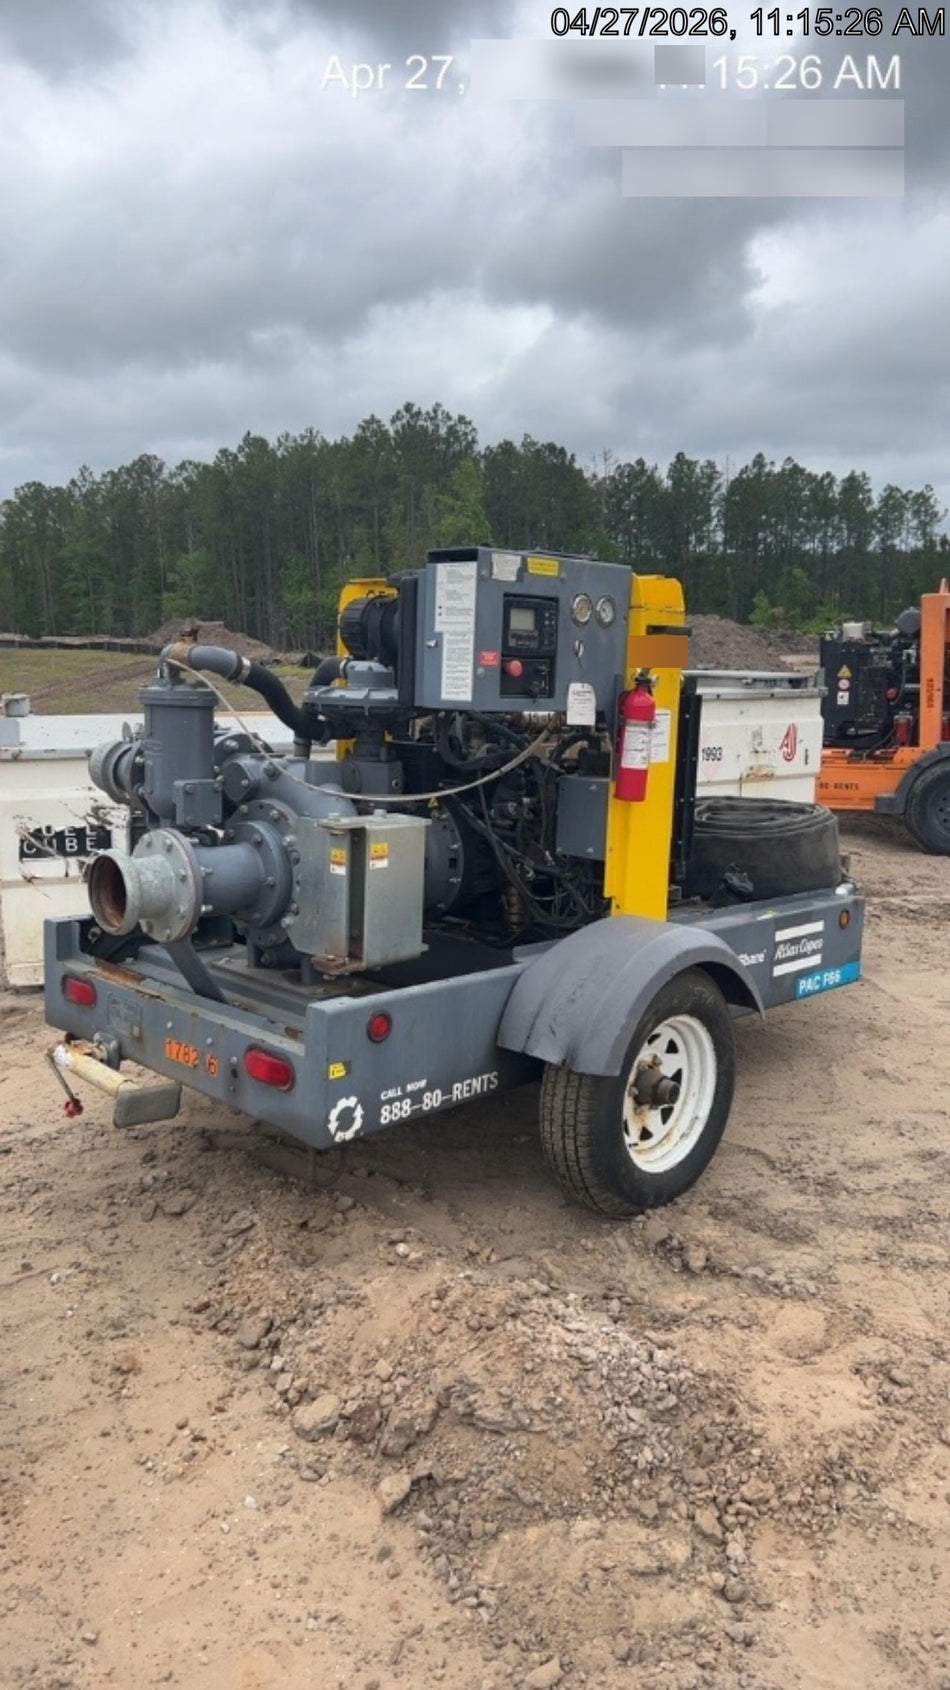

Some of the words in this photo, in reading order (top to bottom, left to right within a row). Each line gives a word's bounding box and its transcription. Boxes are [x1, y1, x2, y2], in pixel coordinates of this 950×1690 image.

[701, 746, 723, 762] 1993
[773, 943, 798, 961] Atlas
[800, 938, 824, 955] Copco
[798, 975, 821, 994] PAC
[379, 1071, 499, 1124] 888-80-RENTS
[380, 1087, 402, 1101] CALL
[406, 1079, 427, 1093] NOW
